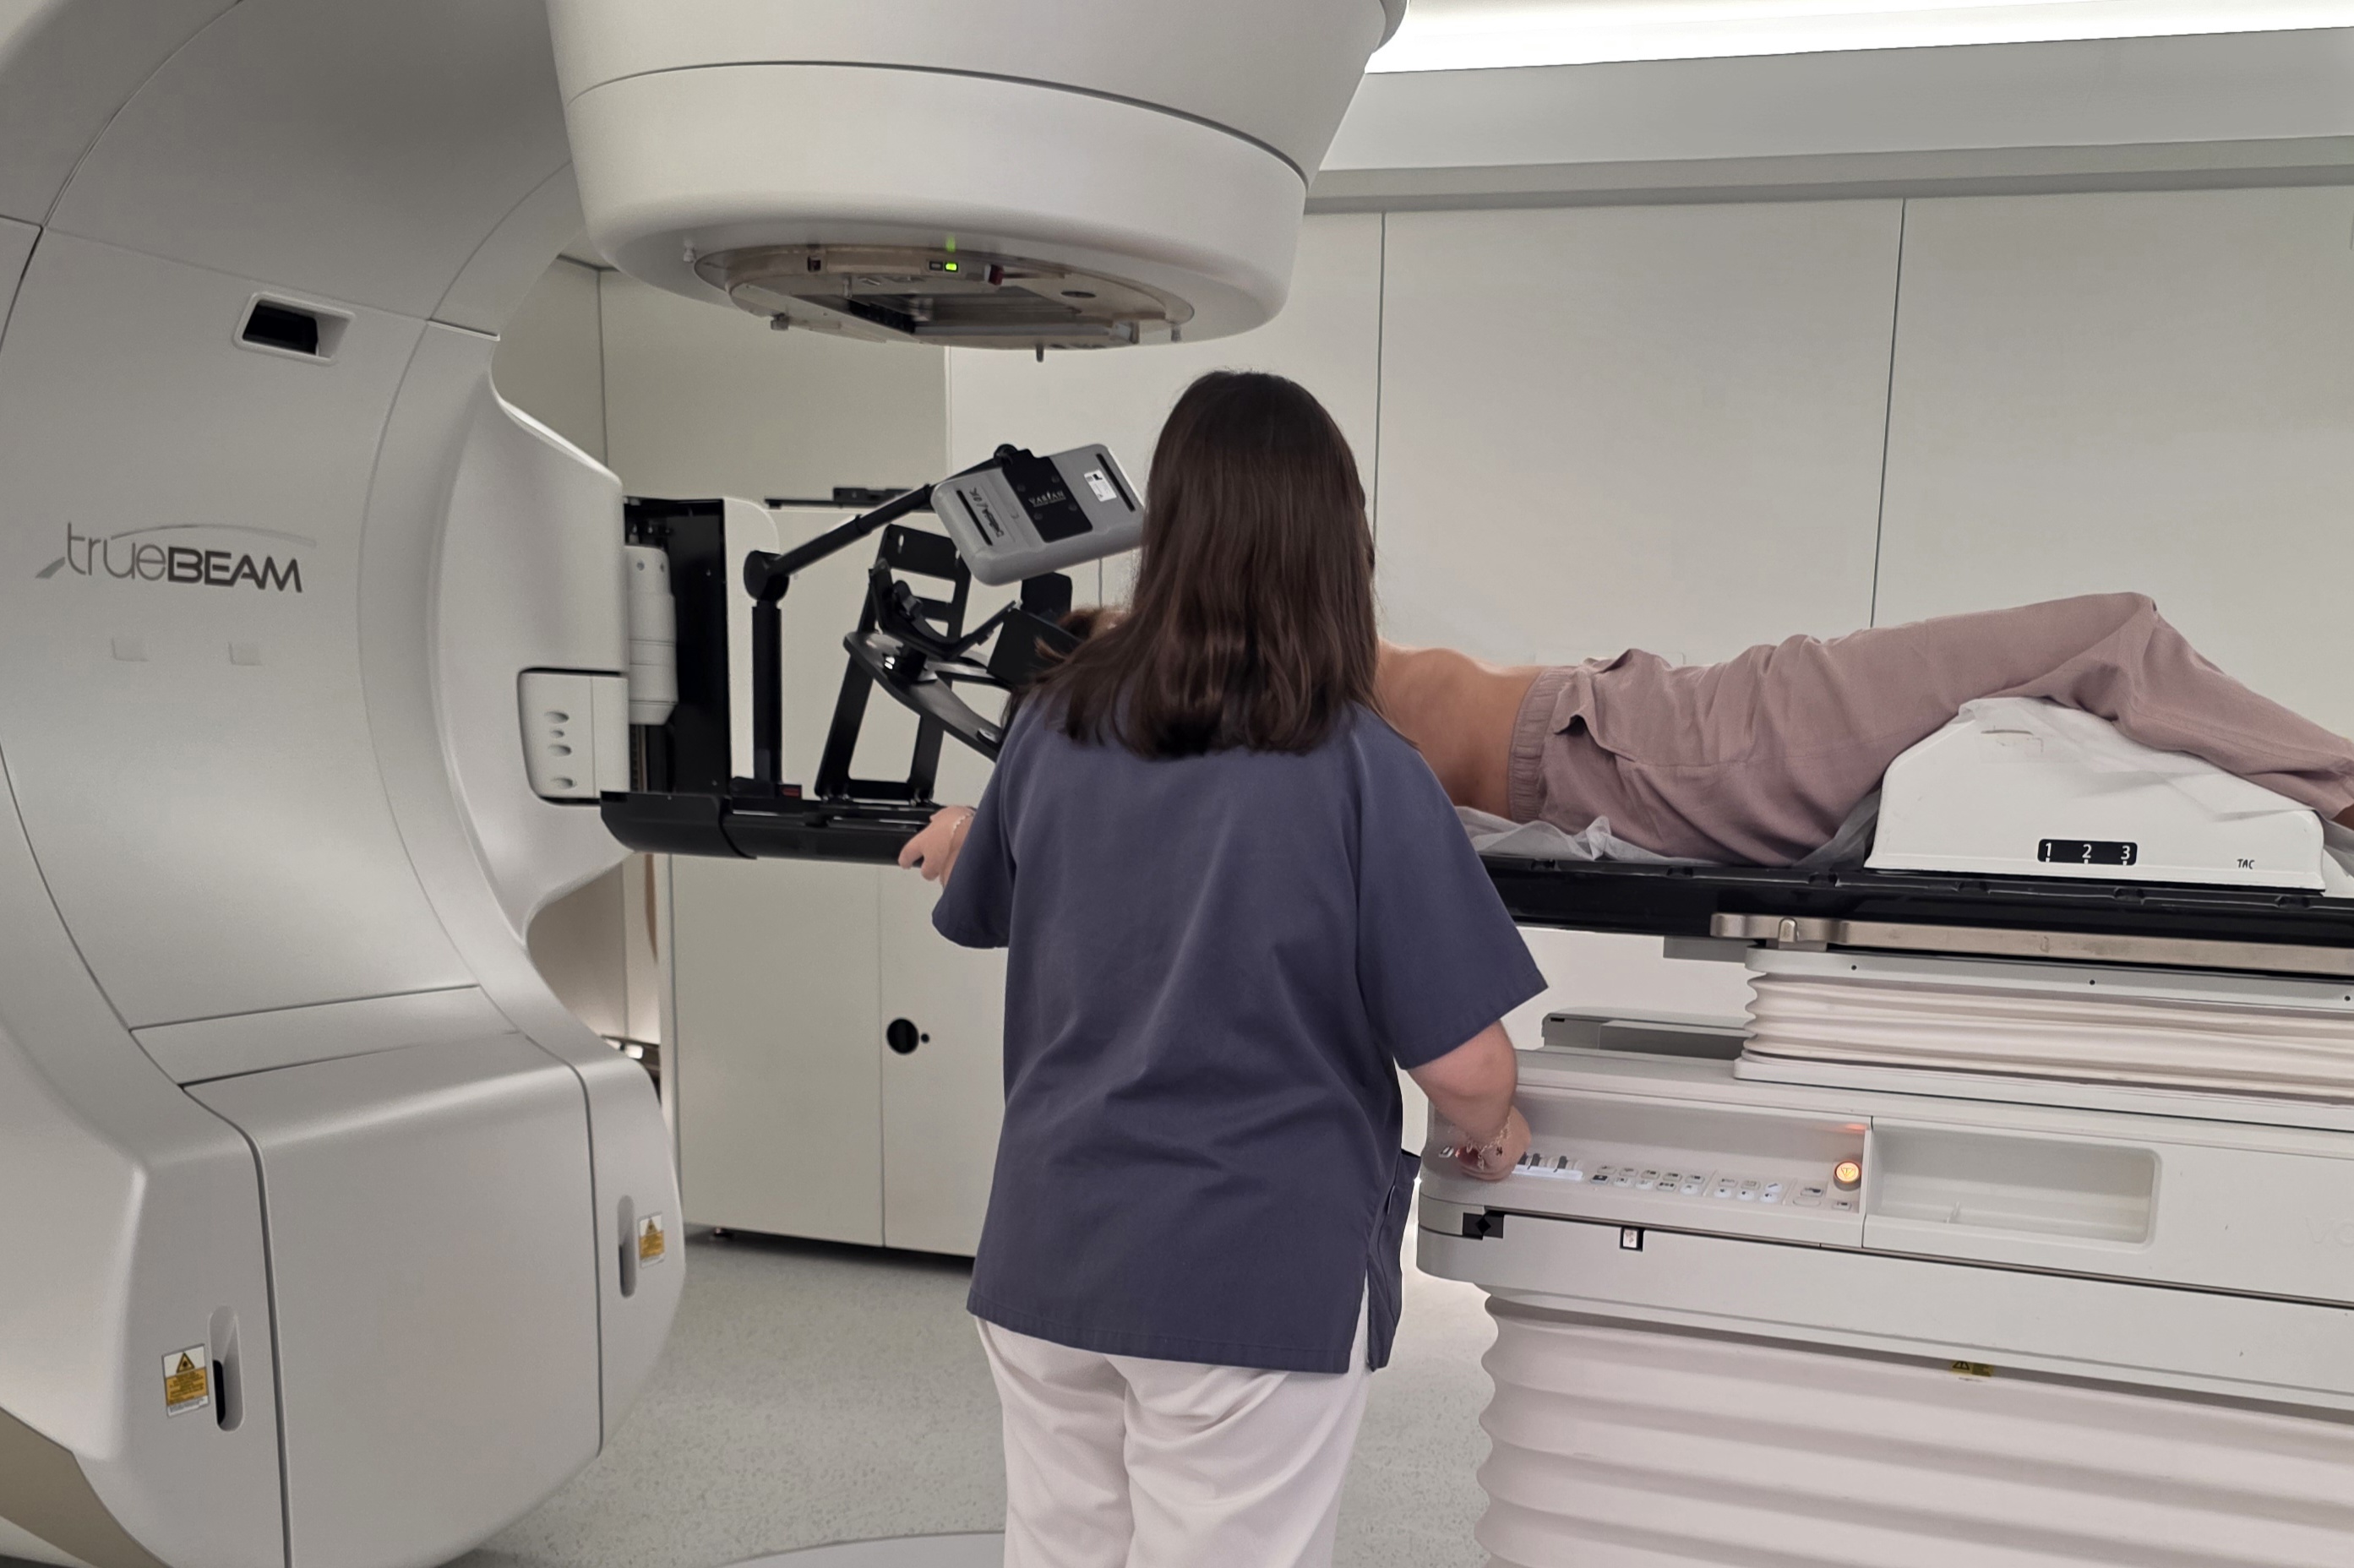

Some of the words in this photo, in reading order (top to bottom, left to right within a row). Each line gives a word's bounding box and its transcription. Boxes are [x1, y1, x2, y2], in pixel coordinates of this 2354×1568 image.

[1027, 490, 1067, 505] VARIAN
[68, 522, 302, 592] trueBEAM
[2045, 842, 2052, 858] 1
[2082, 844, 2093, 859] 2
[2120, 846, 2131, 860] 3
[2237, 858, 2255, 870] TAC
